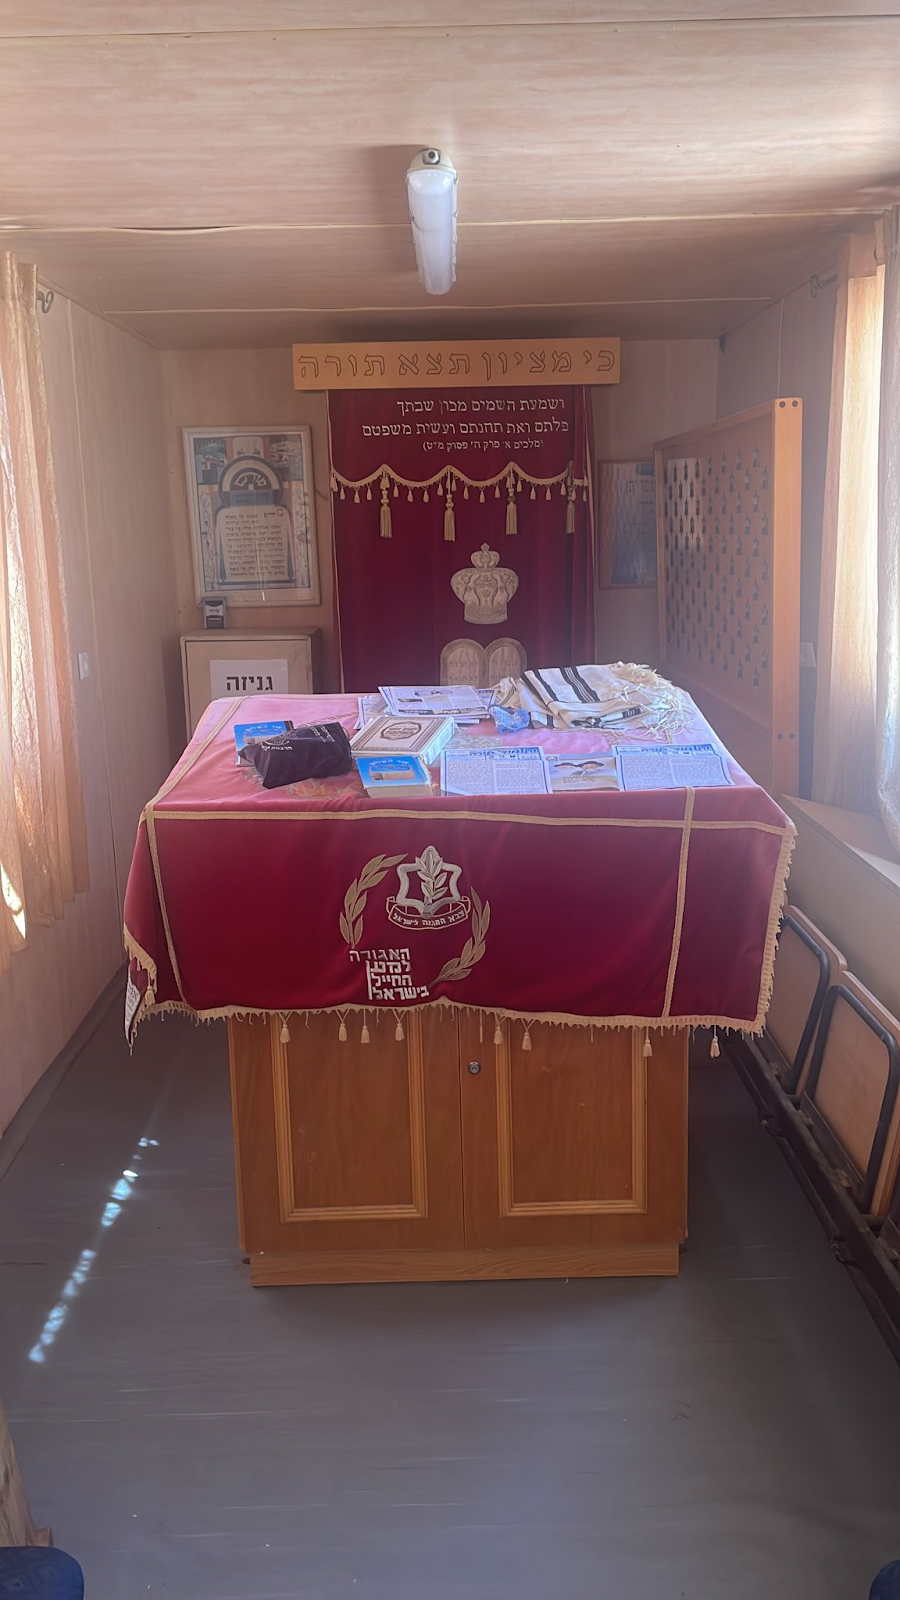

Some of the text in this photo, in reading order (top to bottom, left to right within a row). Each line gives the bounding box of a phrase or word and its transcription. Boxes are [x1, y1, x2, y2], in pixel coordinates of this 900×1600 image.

[298, 350, 615, 381] כי מציון תצא תורה
[396, 398, 565, 417] ושמעת השמים מכון שבתך
[361, 424, 412, 437] משפטם
[416, 422, 456, 435] ועשית
[459, 422, 503, 434] תחנתם
[506, 422, 531, 434] ואת
[446, 441, 468, 453] פסוק
[482, 440, 500, 452] פרק
[226, 676, 274, 691] גניזה
[349, 948, 411, 962] האגורה
[370, 972, 413, 987] החייל
[371, 986, 430, 1000] בישראל
